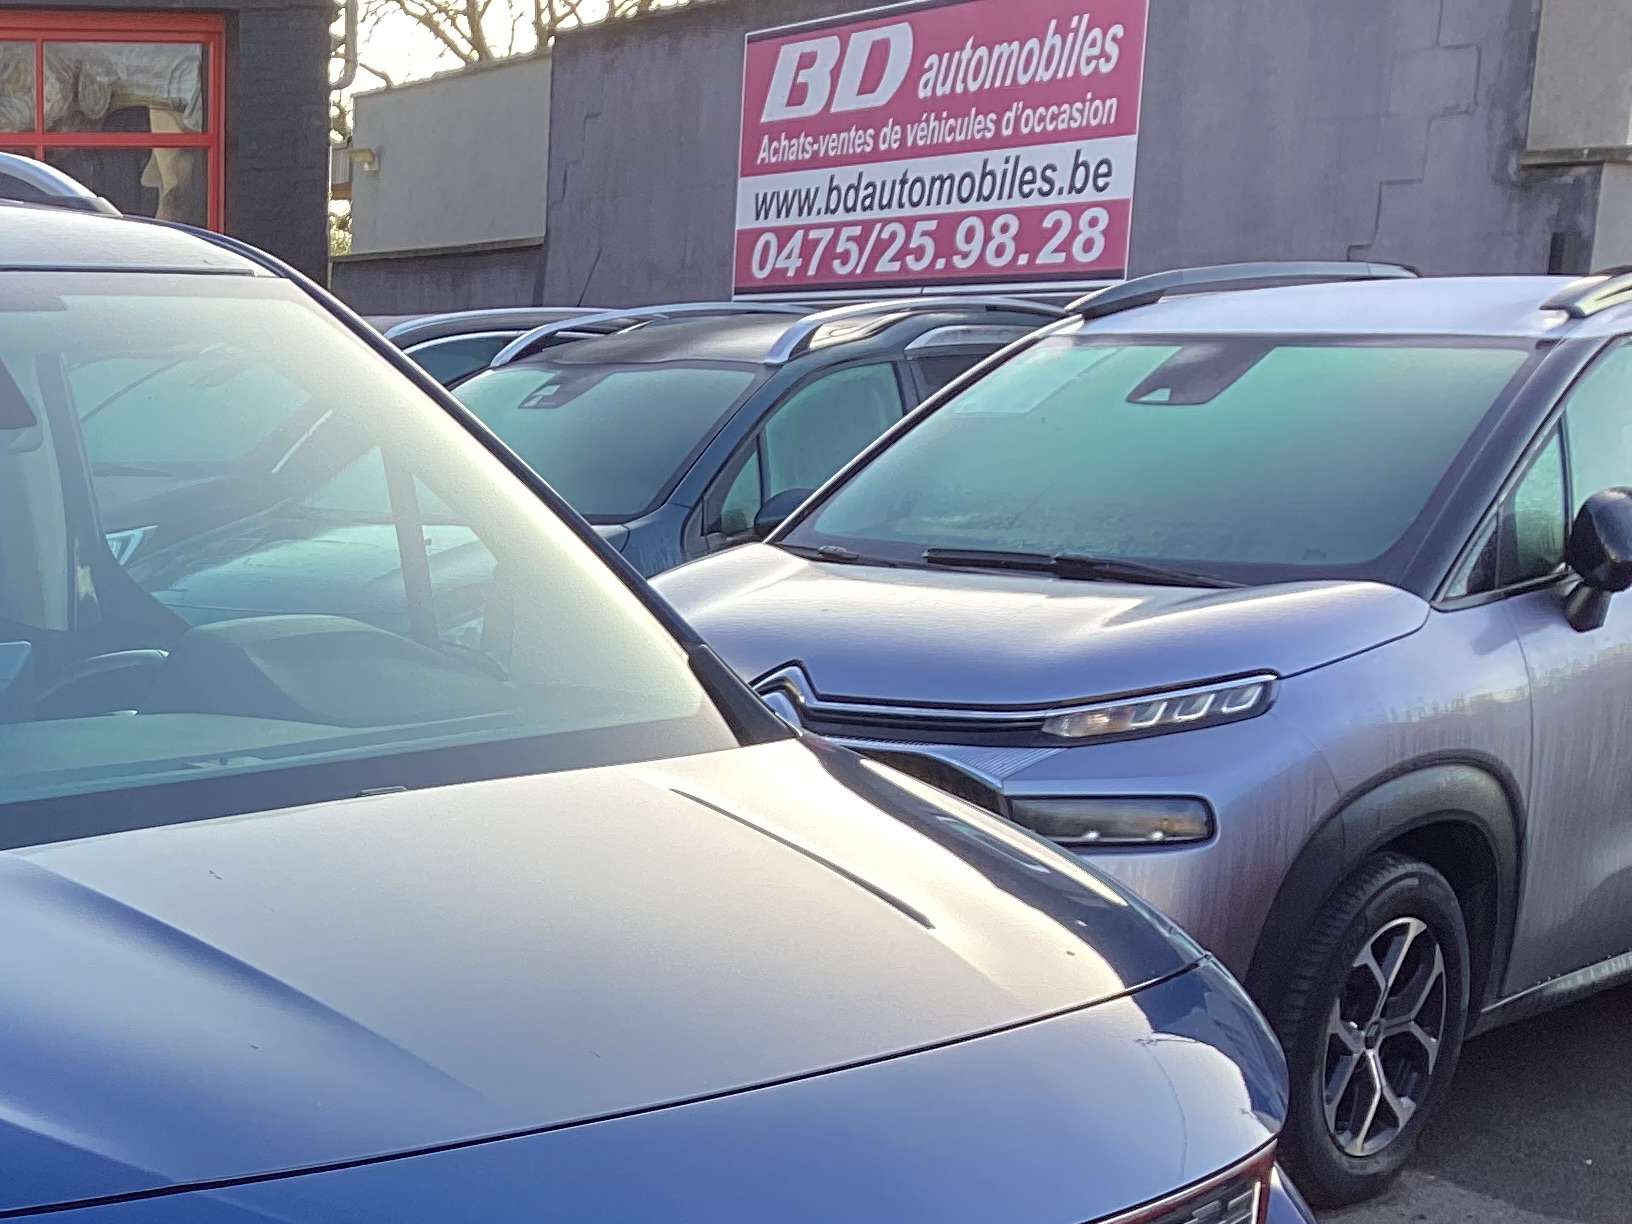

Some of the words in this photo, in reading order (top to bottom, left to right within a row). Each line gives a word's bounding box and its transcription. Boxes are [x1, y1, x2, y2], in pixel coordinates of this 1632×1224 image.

[761, 22, 914, 123] BD
[918, 14, 1125, 99] automobiles
[756, 127, 875, 165] Achats-ventes
[878, 118, 902, 152] de
[906, 109, 996, 147] véhicules
[1001, 92, 1118, 134] d'occasion
[754, 149, 1113, 221] www.bdautomobiles.be
[751, 206, 1110, 280] 0475/25.98.28
